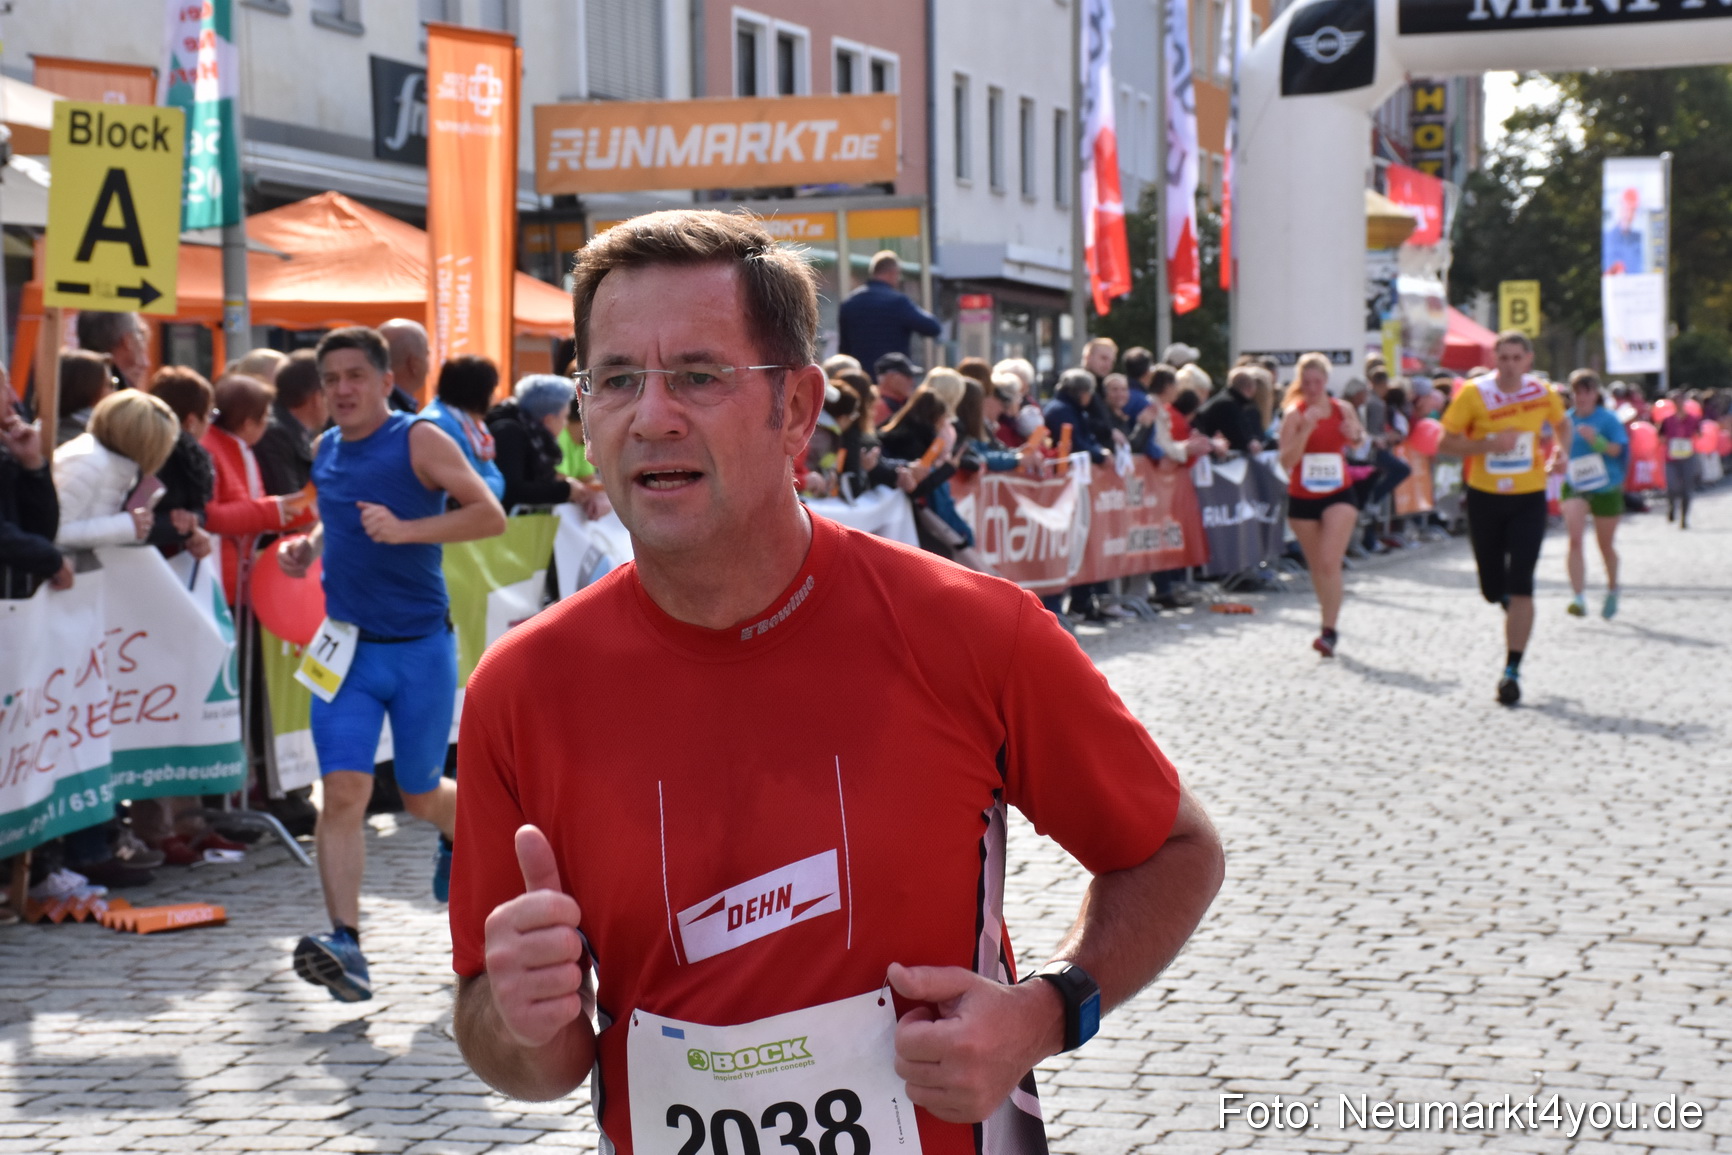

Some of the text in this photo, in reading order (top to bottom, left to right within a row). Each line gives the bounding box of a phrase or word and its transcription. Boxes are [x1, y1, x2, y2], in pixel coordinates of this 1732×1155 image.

[68, 109, 170, 152] Block
[74, 166, 150, 268] A
[1510, 298, 1529, 325] B
[317, 633, 340, 663] 71
[727, 882, 793, 933] DEHN
[710, 1036, 813, 1074] BOCK
[713, 1058, 815, 1082] inspired by smart concepts
[665, 1088, 872, 1155] 2038
